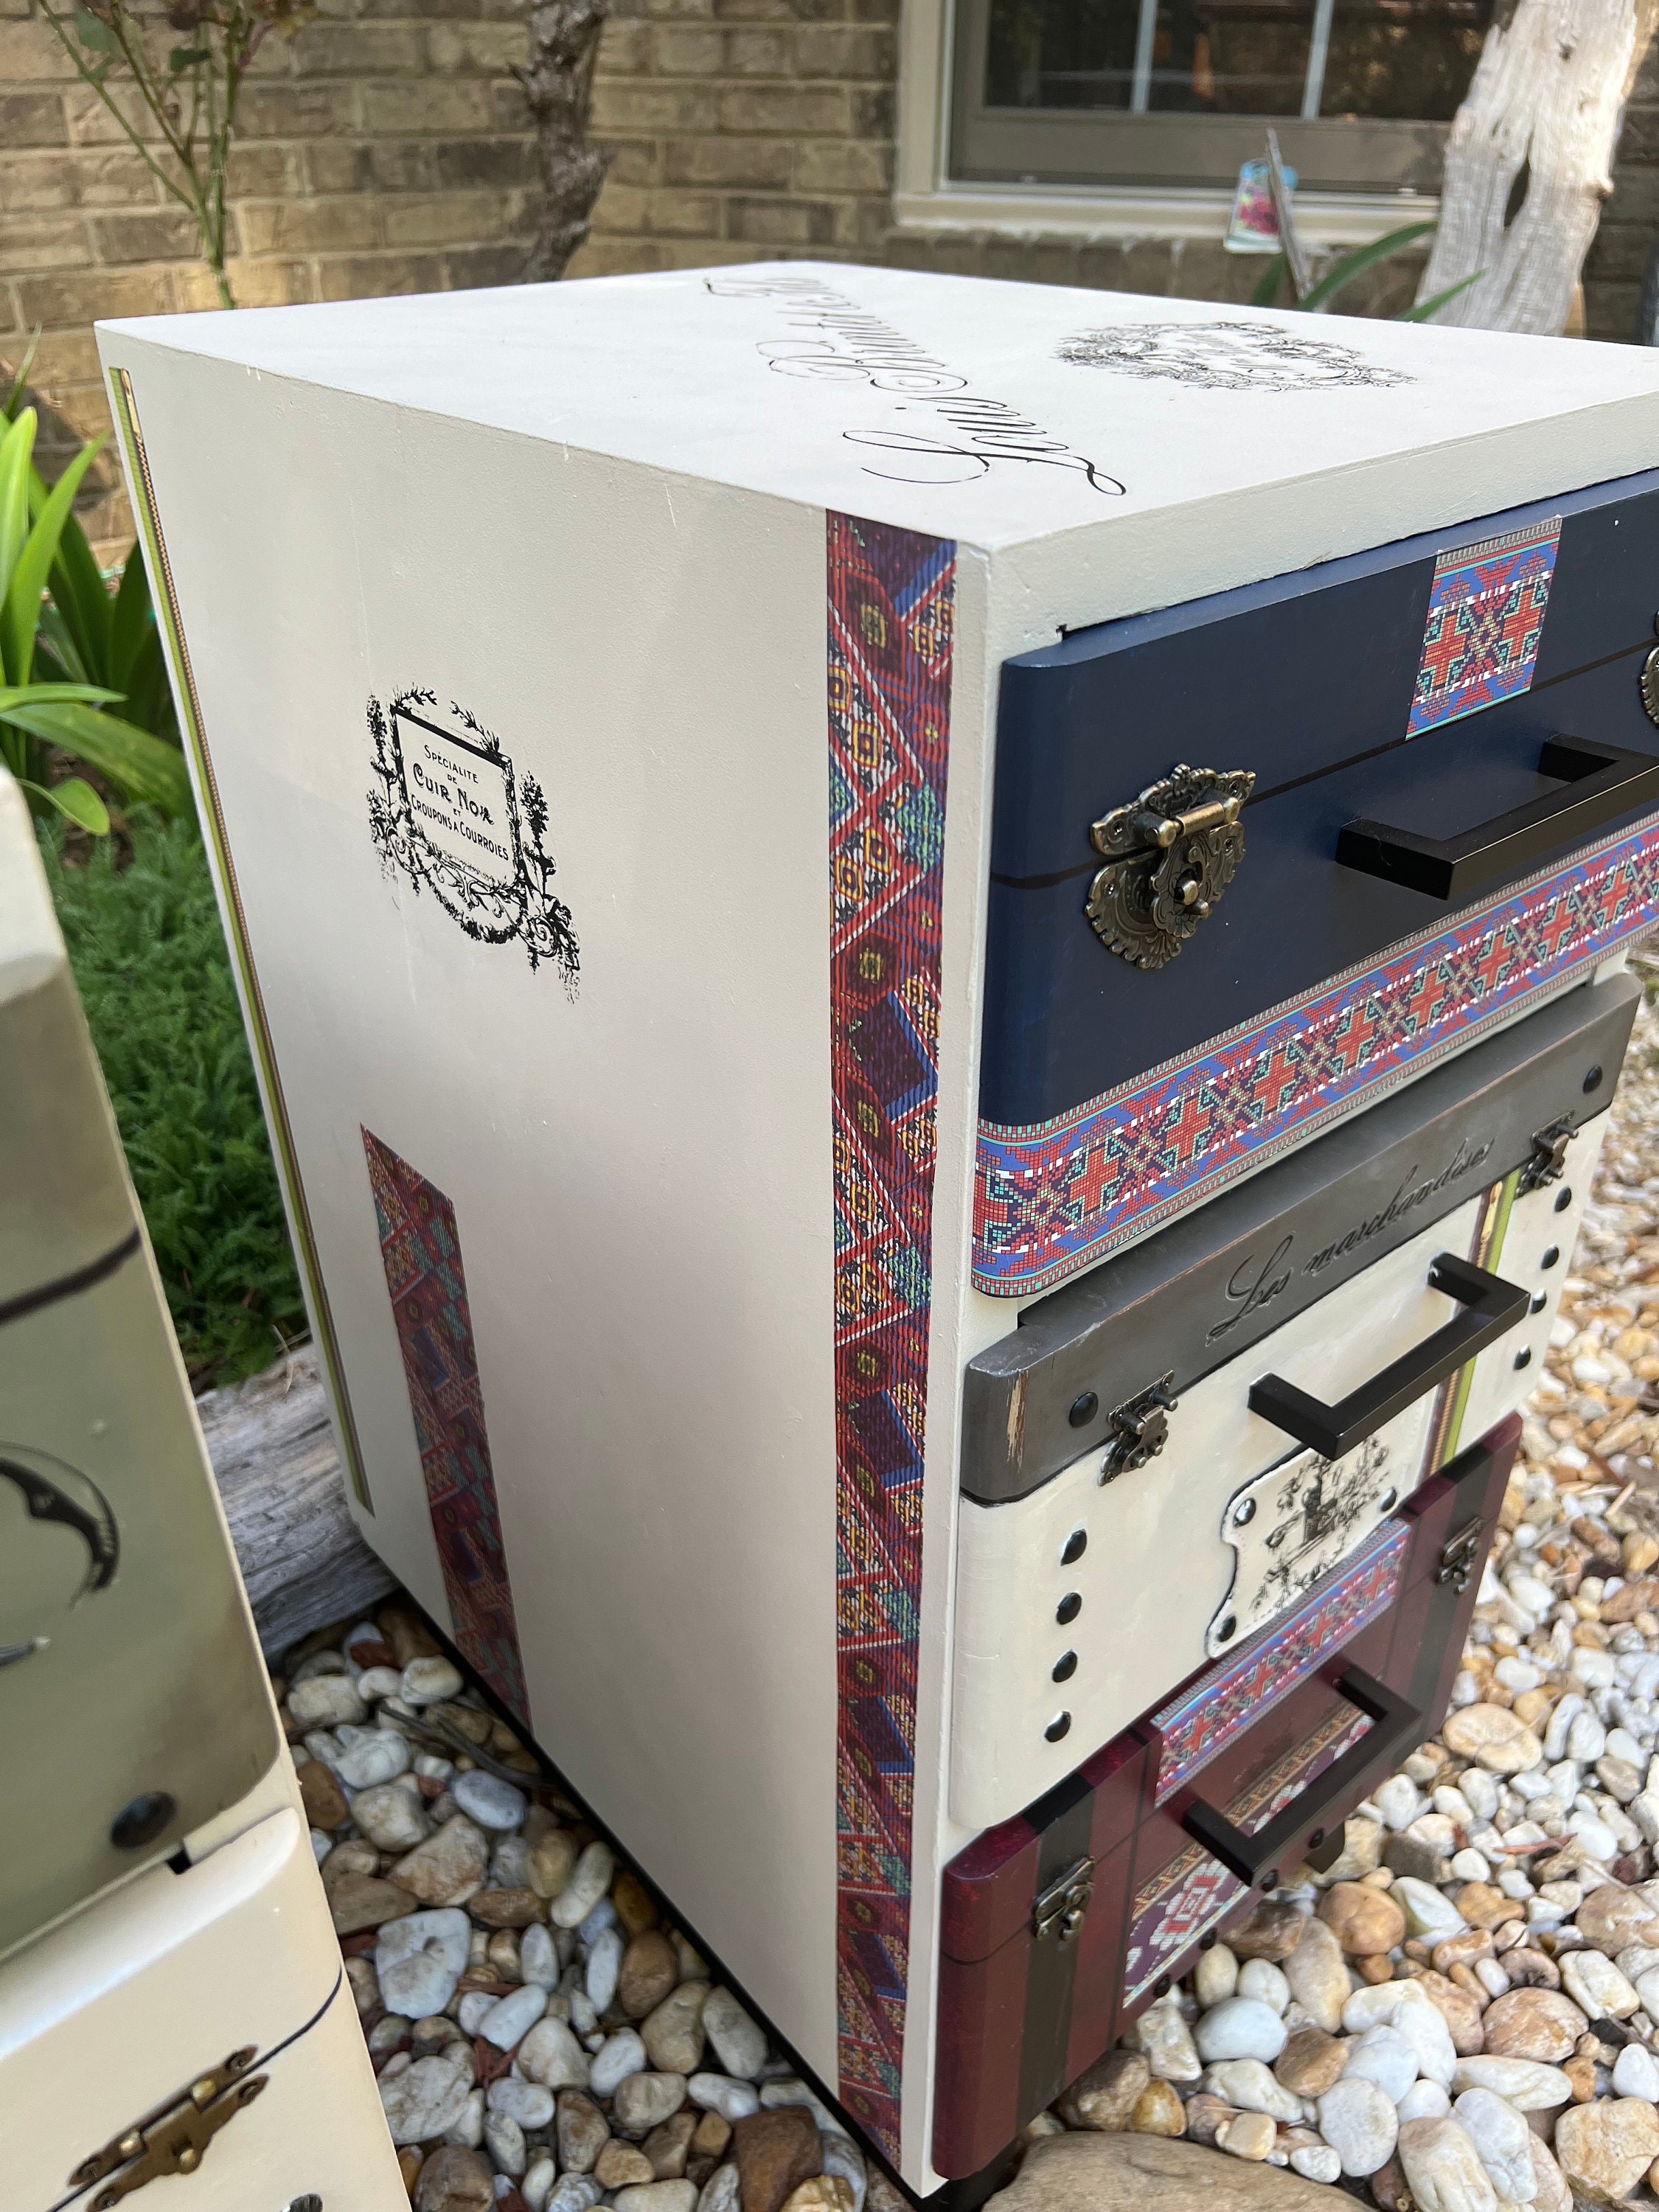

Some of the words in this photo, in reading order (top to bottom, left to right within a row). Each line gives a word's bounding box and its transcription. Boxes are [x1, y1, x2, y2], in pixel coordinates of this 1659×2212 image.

[413, 762, 453, 804] CUIR
[447, 773, 458, 785] DE
[411, 793, 453, 831] CROUPONS
[459, 821, 509, 861] COURROIES
[453, 807, 462, 817] ET
[1206, 1231, 1295, 1346] Les
